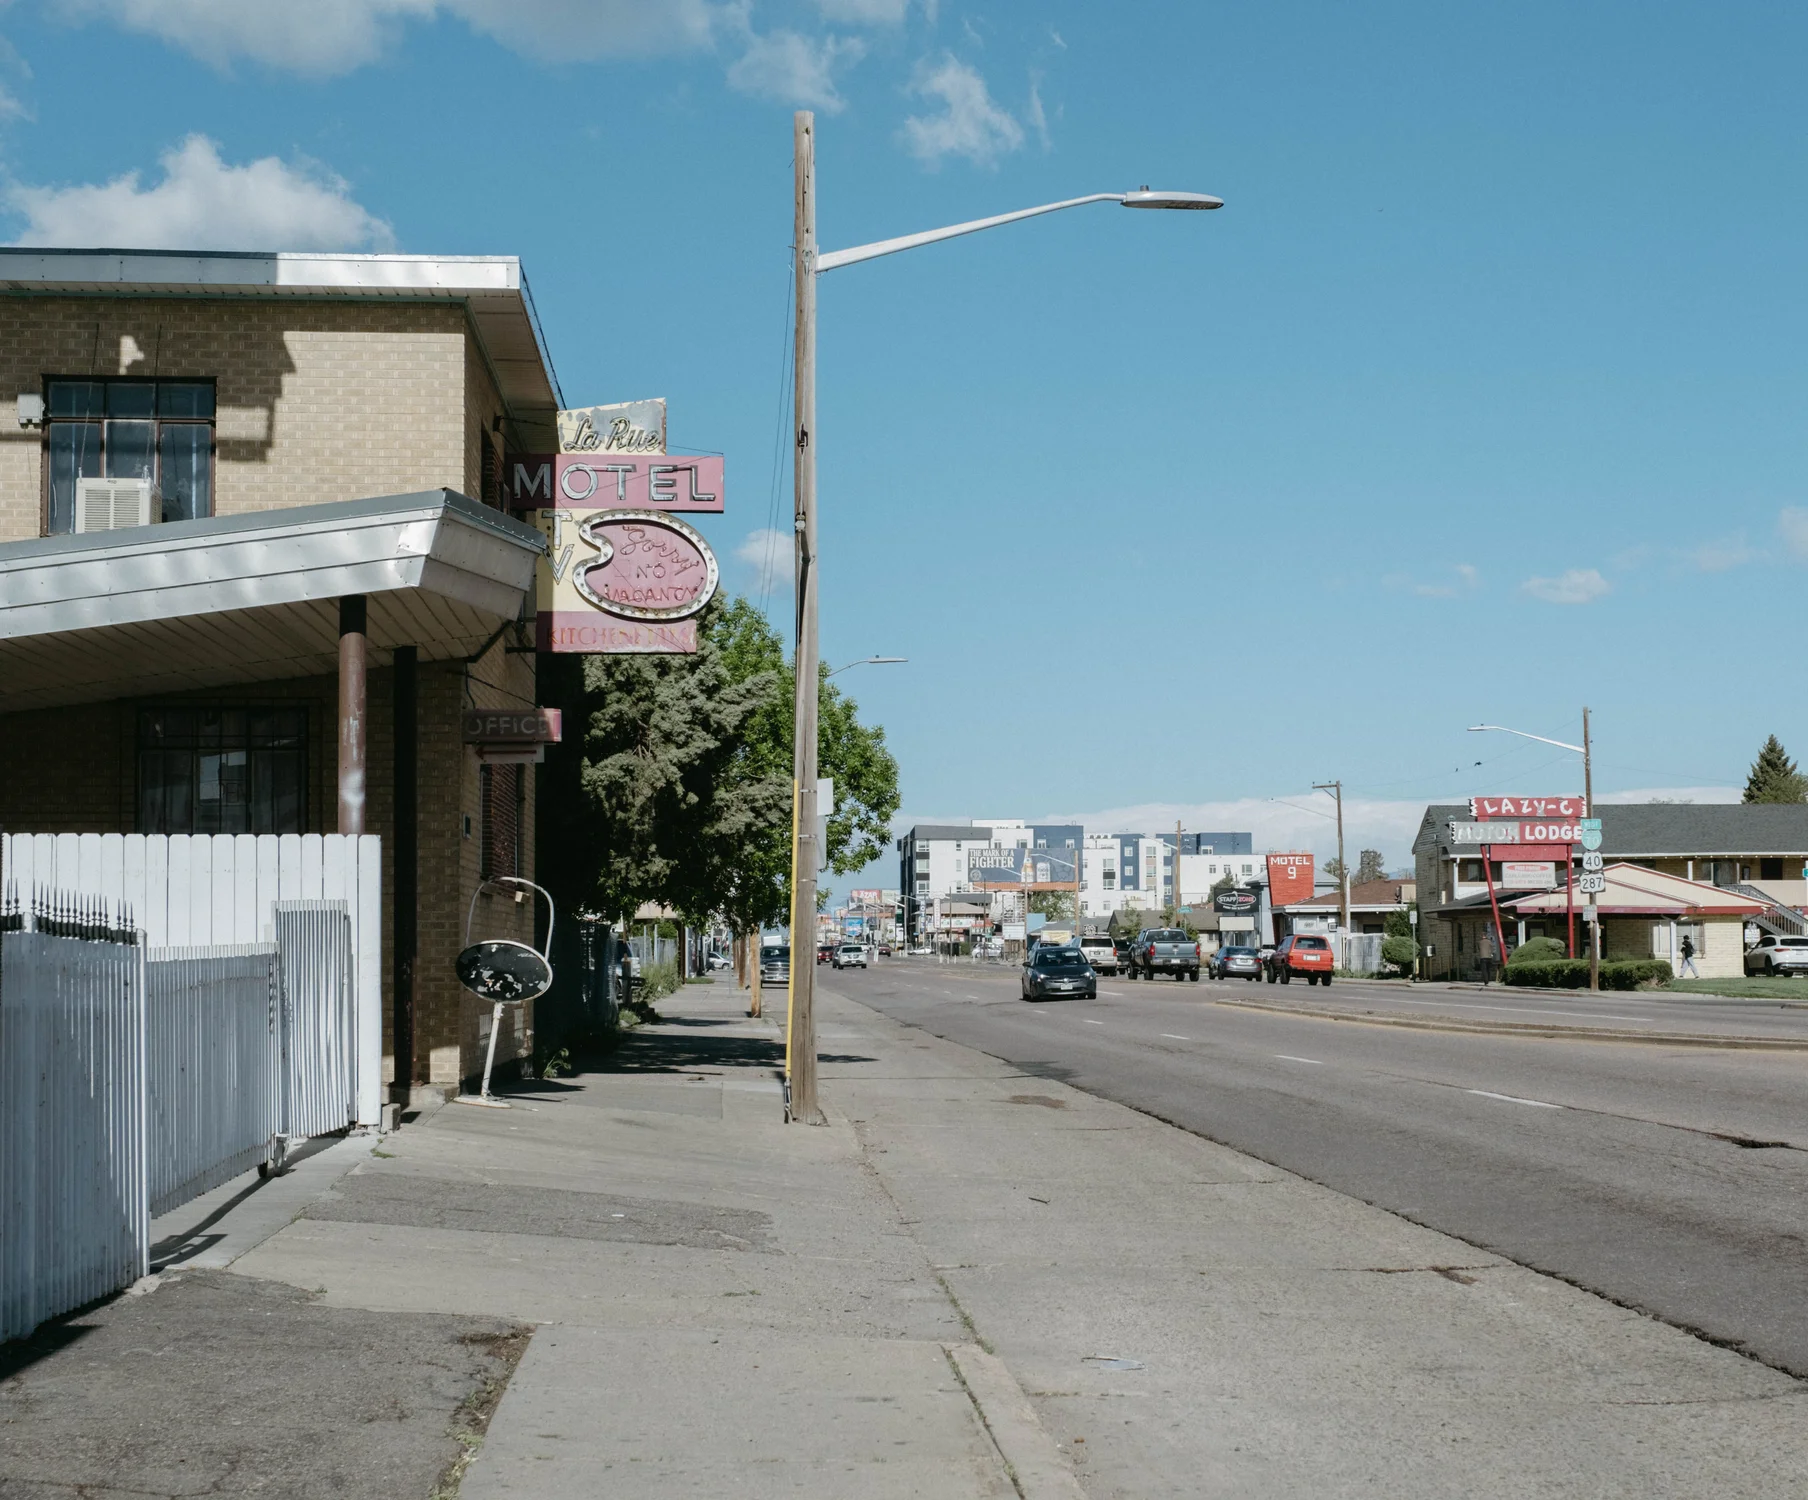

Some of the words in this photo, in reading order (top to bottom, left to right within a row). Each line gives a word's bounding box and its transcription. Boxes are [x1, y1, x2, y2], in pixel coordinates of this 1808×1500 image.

[563, 416, 601, 452] La
[605, 416, 663, 452] Rue
[512, 462, 716, 502] MOTEL
[620, 524, 700, 576] Sorry
[635, 562, 667, 579] NO
[604, 584, 703, 603] VACANCY
[465, 716, 550, 735] OFFICE
[1483, 798, 1574, 816] LAZY-C
[1524, 824, 1582, 841] LODGE
[1585, 836, 1600, 846] 70
[969, 849, 981, 857] THE
[981, 849, 999, 857] MARK
[1000, 849, 1009, 857] OF
[1010, 849, 1014, 857] A
[1270, 856, 1310, 866] MOTEL
[1585, 855, 1601, 867] 40
[969, 856, 1014, 868] FIGHTER
[1287, 867, 1297, 879] 9
[1582, 876, 1603, 890] 287
